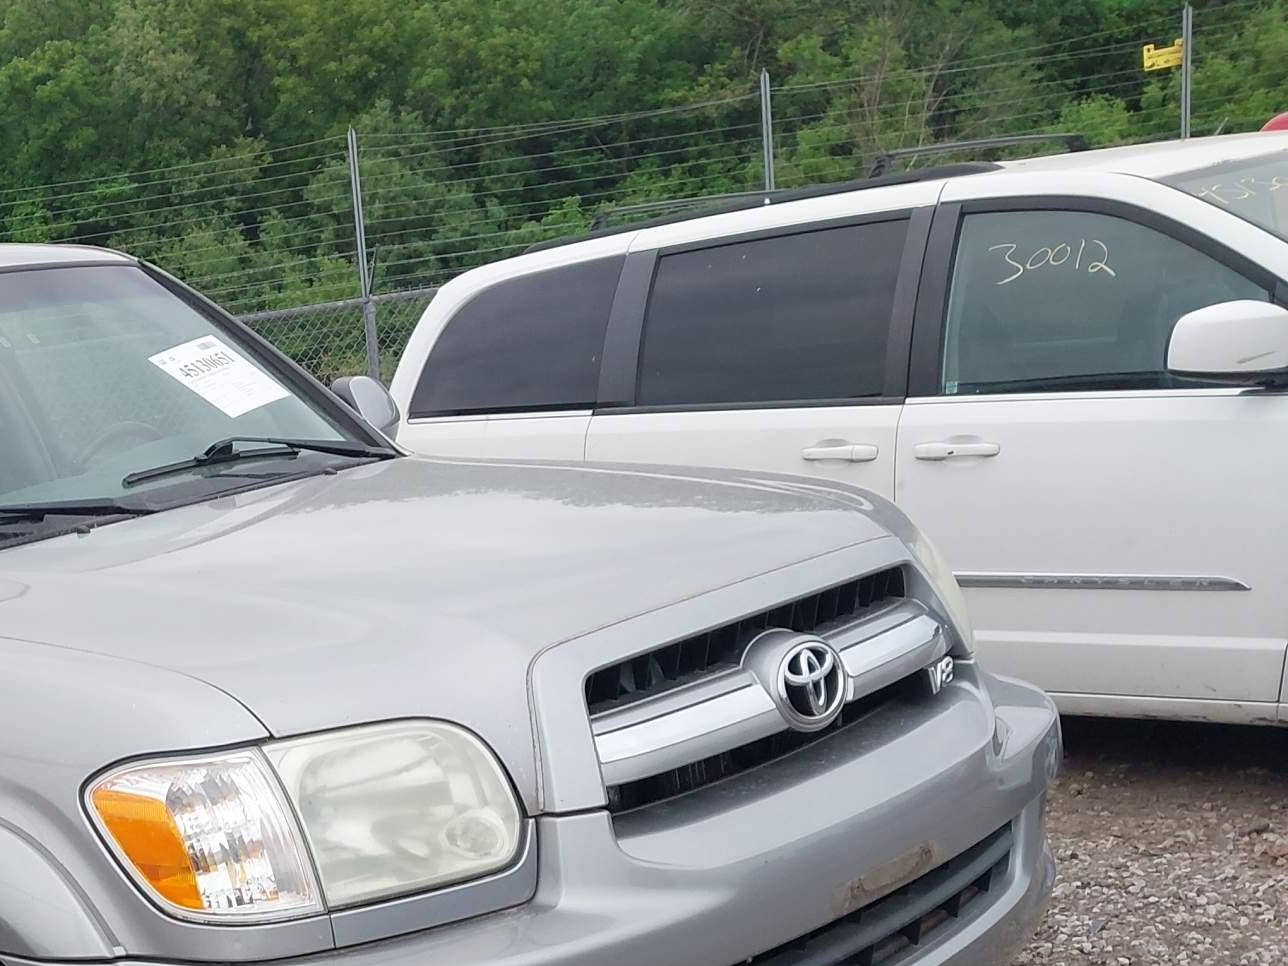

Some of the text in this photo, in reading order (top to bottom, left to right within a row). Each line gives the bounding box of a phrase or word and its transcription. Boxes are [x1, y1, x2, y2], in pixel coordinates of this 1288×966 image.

[987, 239, 1116, 285] 30012
[178, 351, 235, 378] 45130651
[928, 656, 954, 695] V8
